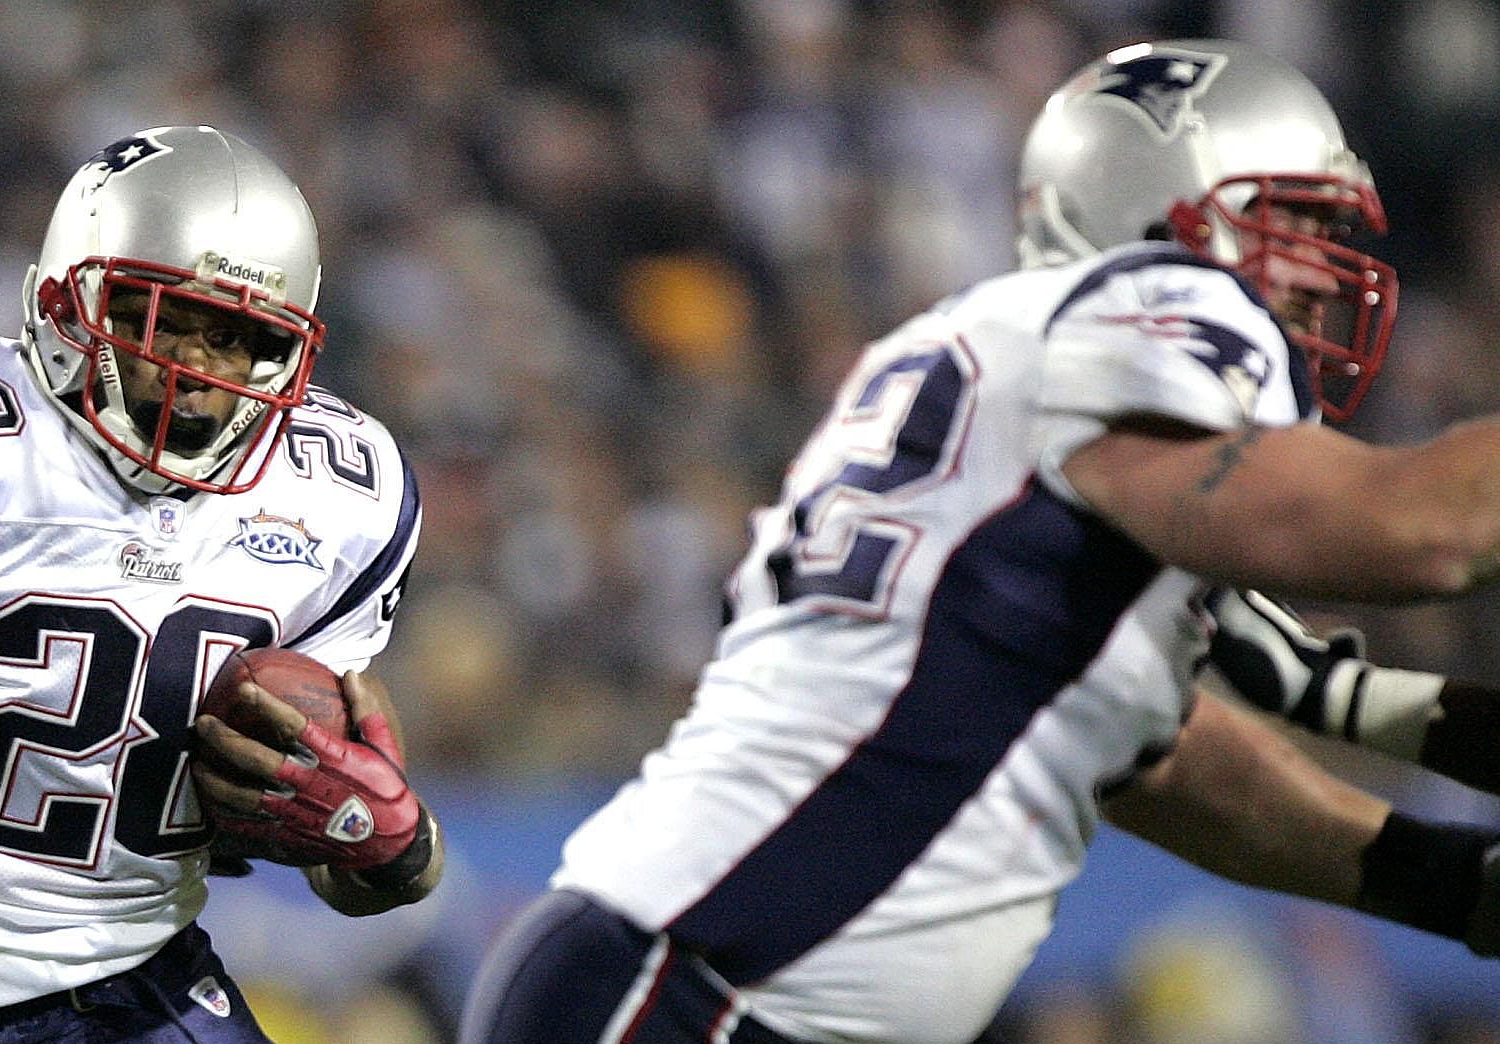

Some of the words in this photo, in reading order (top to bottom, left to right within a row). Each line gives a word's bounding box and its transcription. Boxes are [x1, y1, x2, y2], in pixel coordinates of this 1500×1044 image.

[217, 257, 264, 284] Riddell
[99, 340, 117, 384] ddell
[230, 517, 325, 571] XXXIX
[121, 551, 182, 582] Patriots
